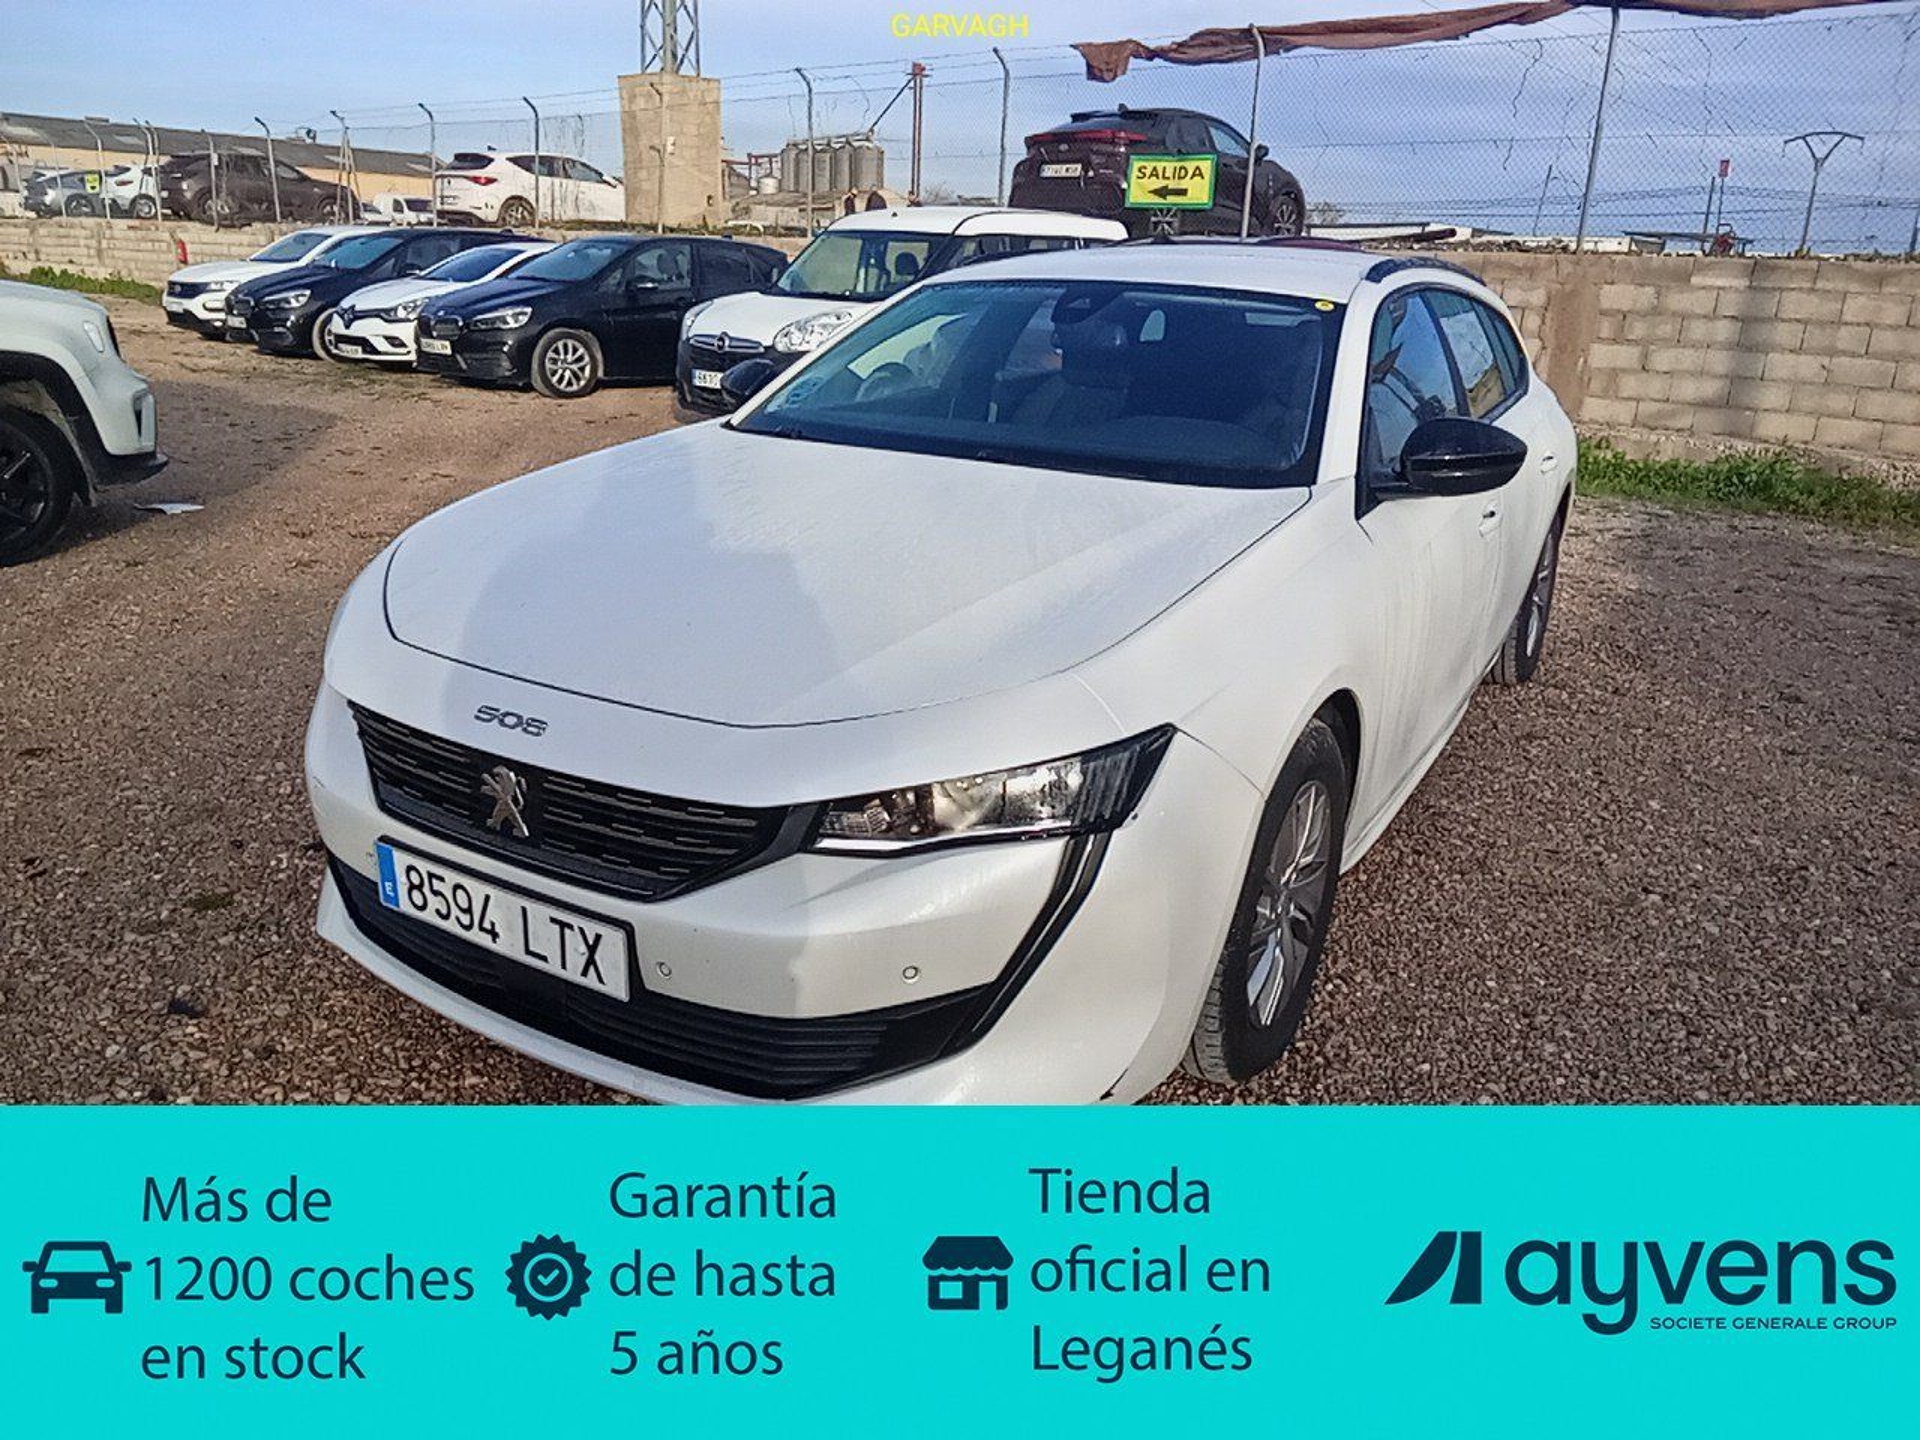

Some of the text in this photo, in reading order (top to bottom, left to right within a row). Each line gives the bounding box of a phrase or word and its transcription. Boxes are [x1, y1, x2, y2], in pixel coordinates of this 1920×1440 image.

[1136, 165, 1205, 181] SALIDA
[474, 705, 548, 737] 508
[385, 881, 395, 897] E
[405, 864, 606, 986] 8594 LTX
